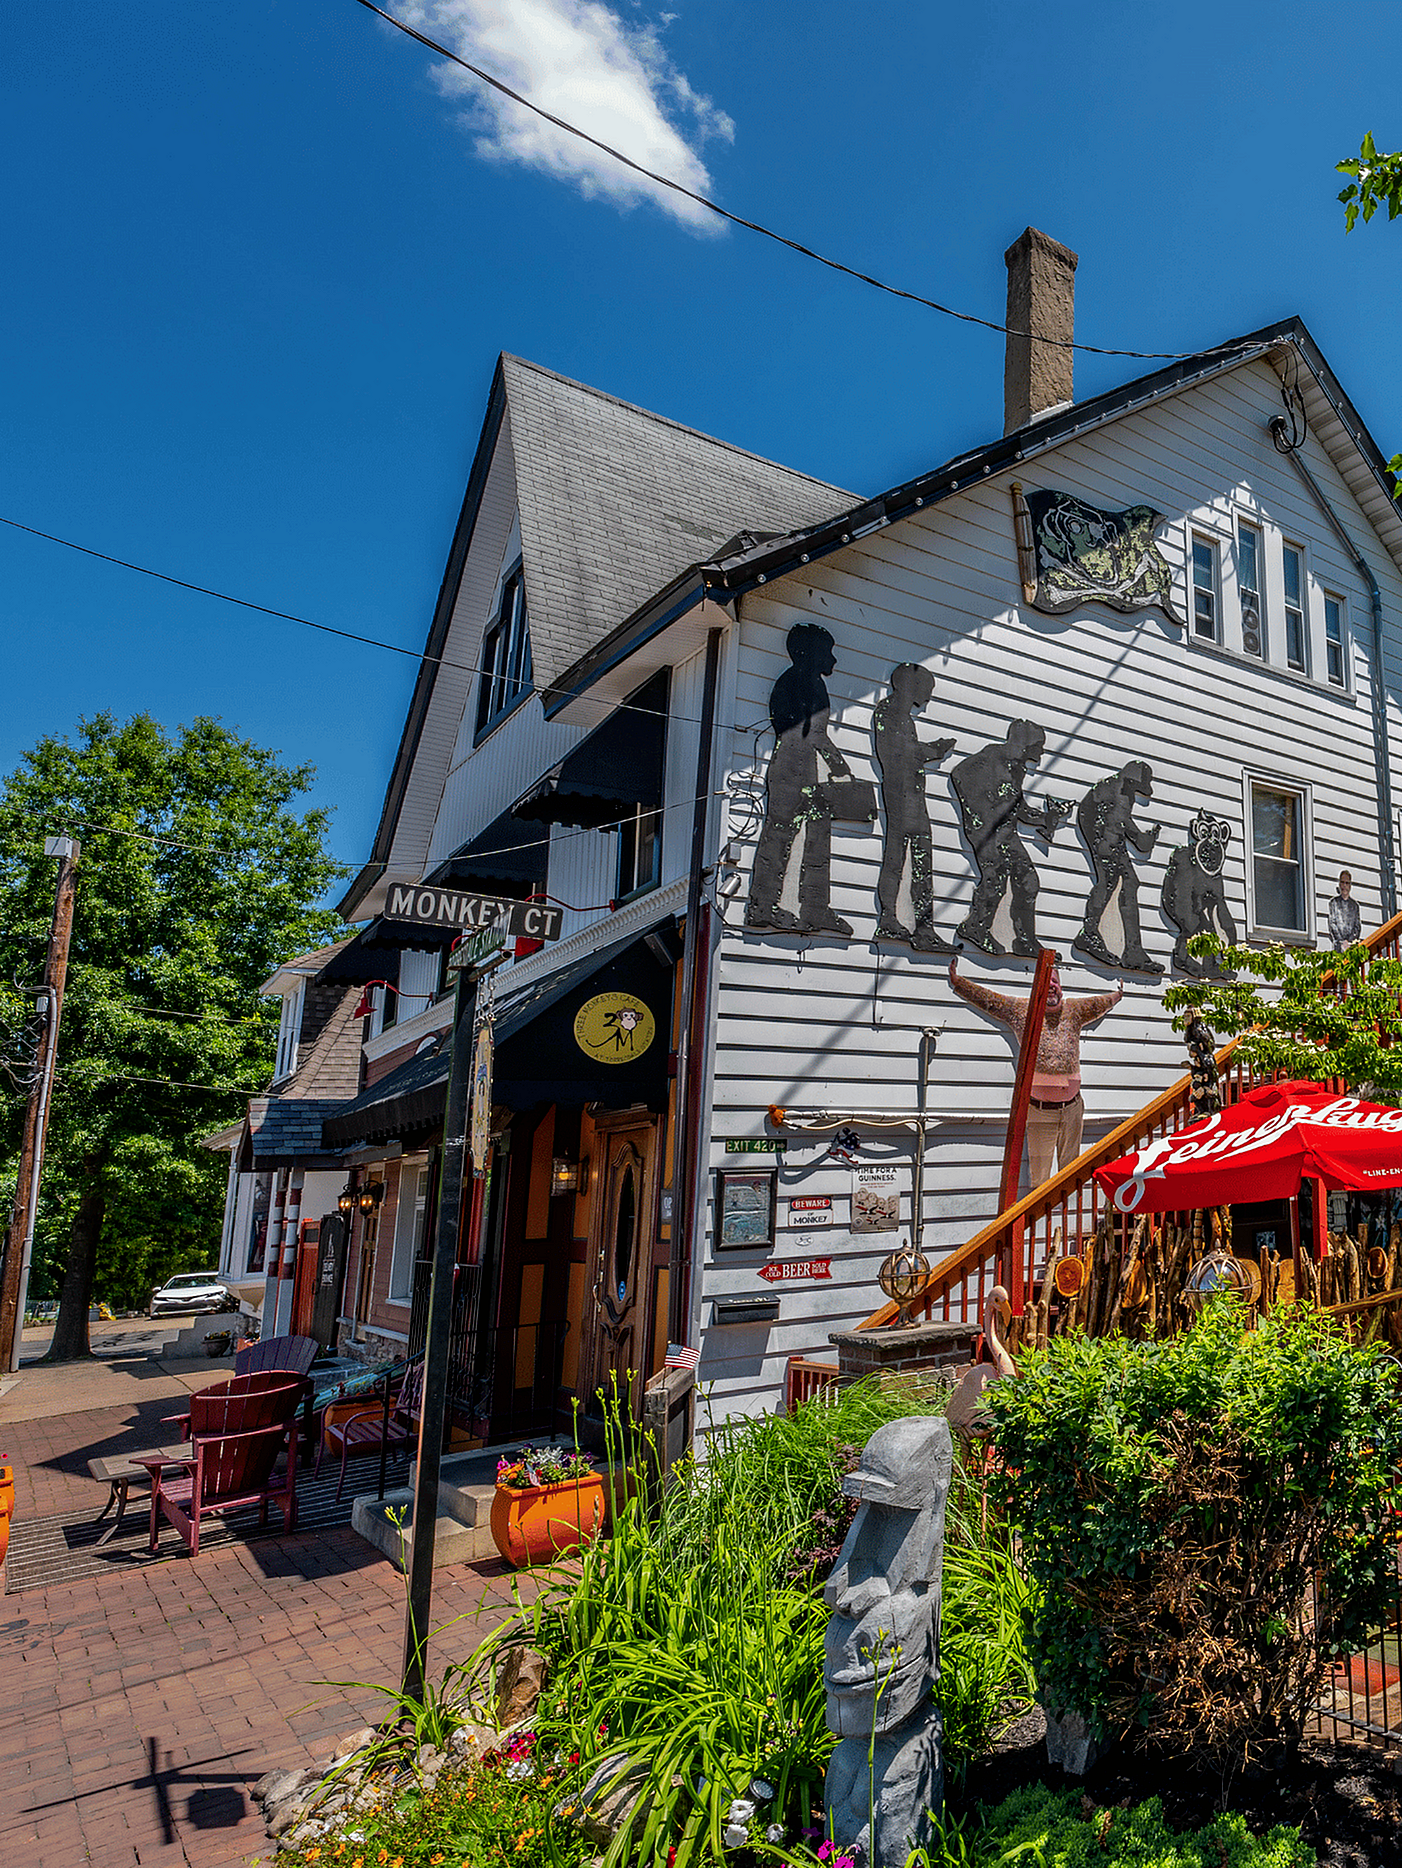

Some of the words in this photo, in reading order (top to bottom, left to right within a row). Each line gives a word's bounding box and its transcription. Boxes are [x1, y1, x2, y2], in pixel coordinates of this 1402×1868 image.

[524, 908, 558, 937] CT
[726, 1140, 750, 1152] EXIT
[753, 1140, 776, 1152] 420
[795, 1199, 827, 1208] BEWARE
[794, 1216, 828, 1225] MONKEY
[782, 1262, 811, 1278] BEER
